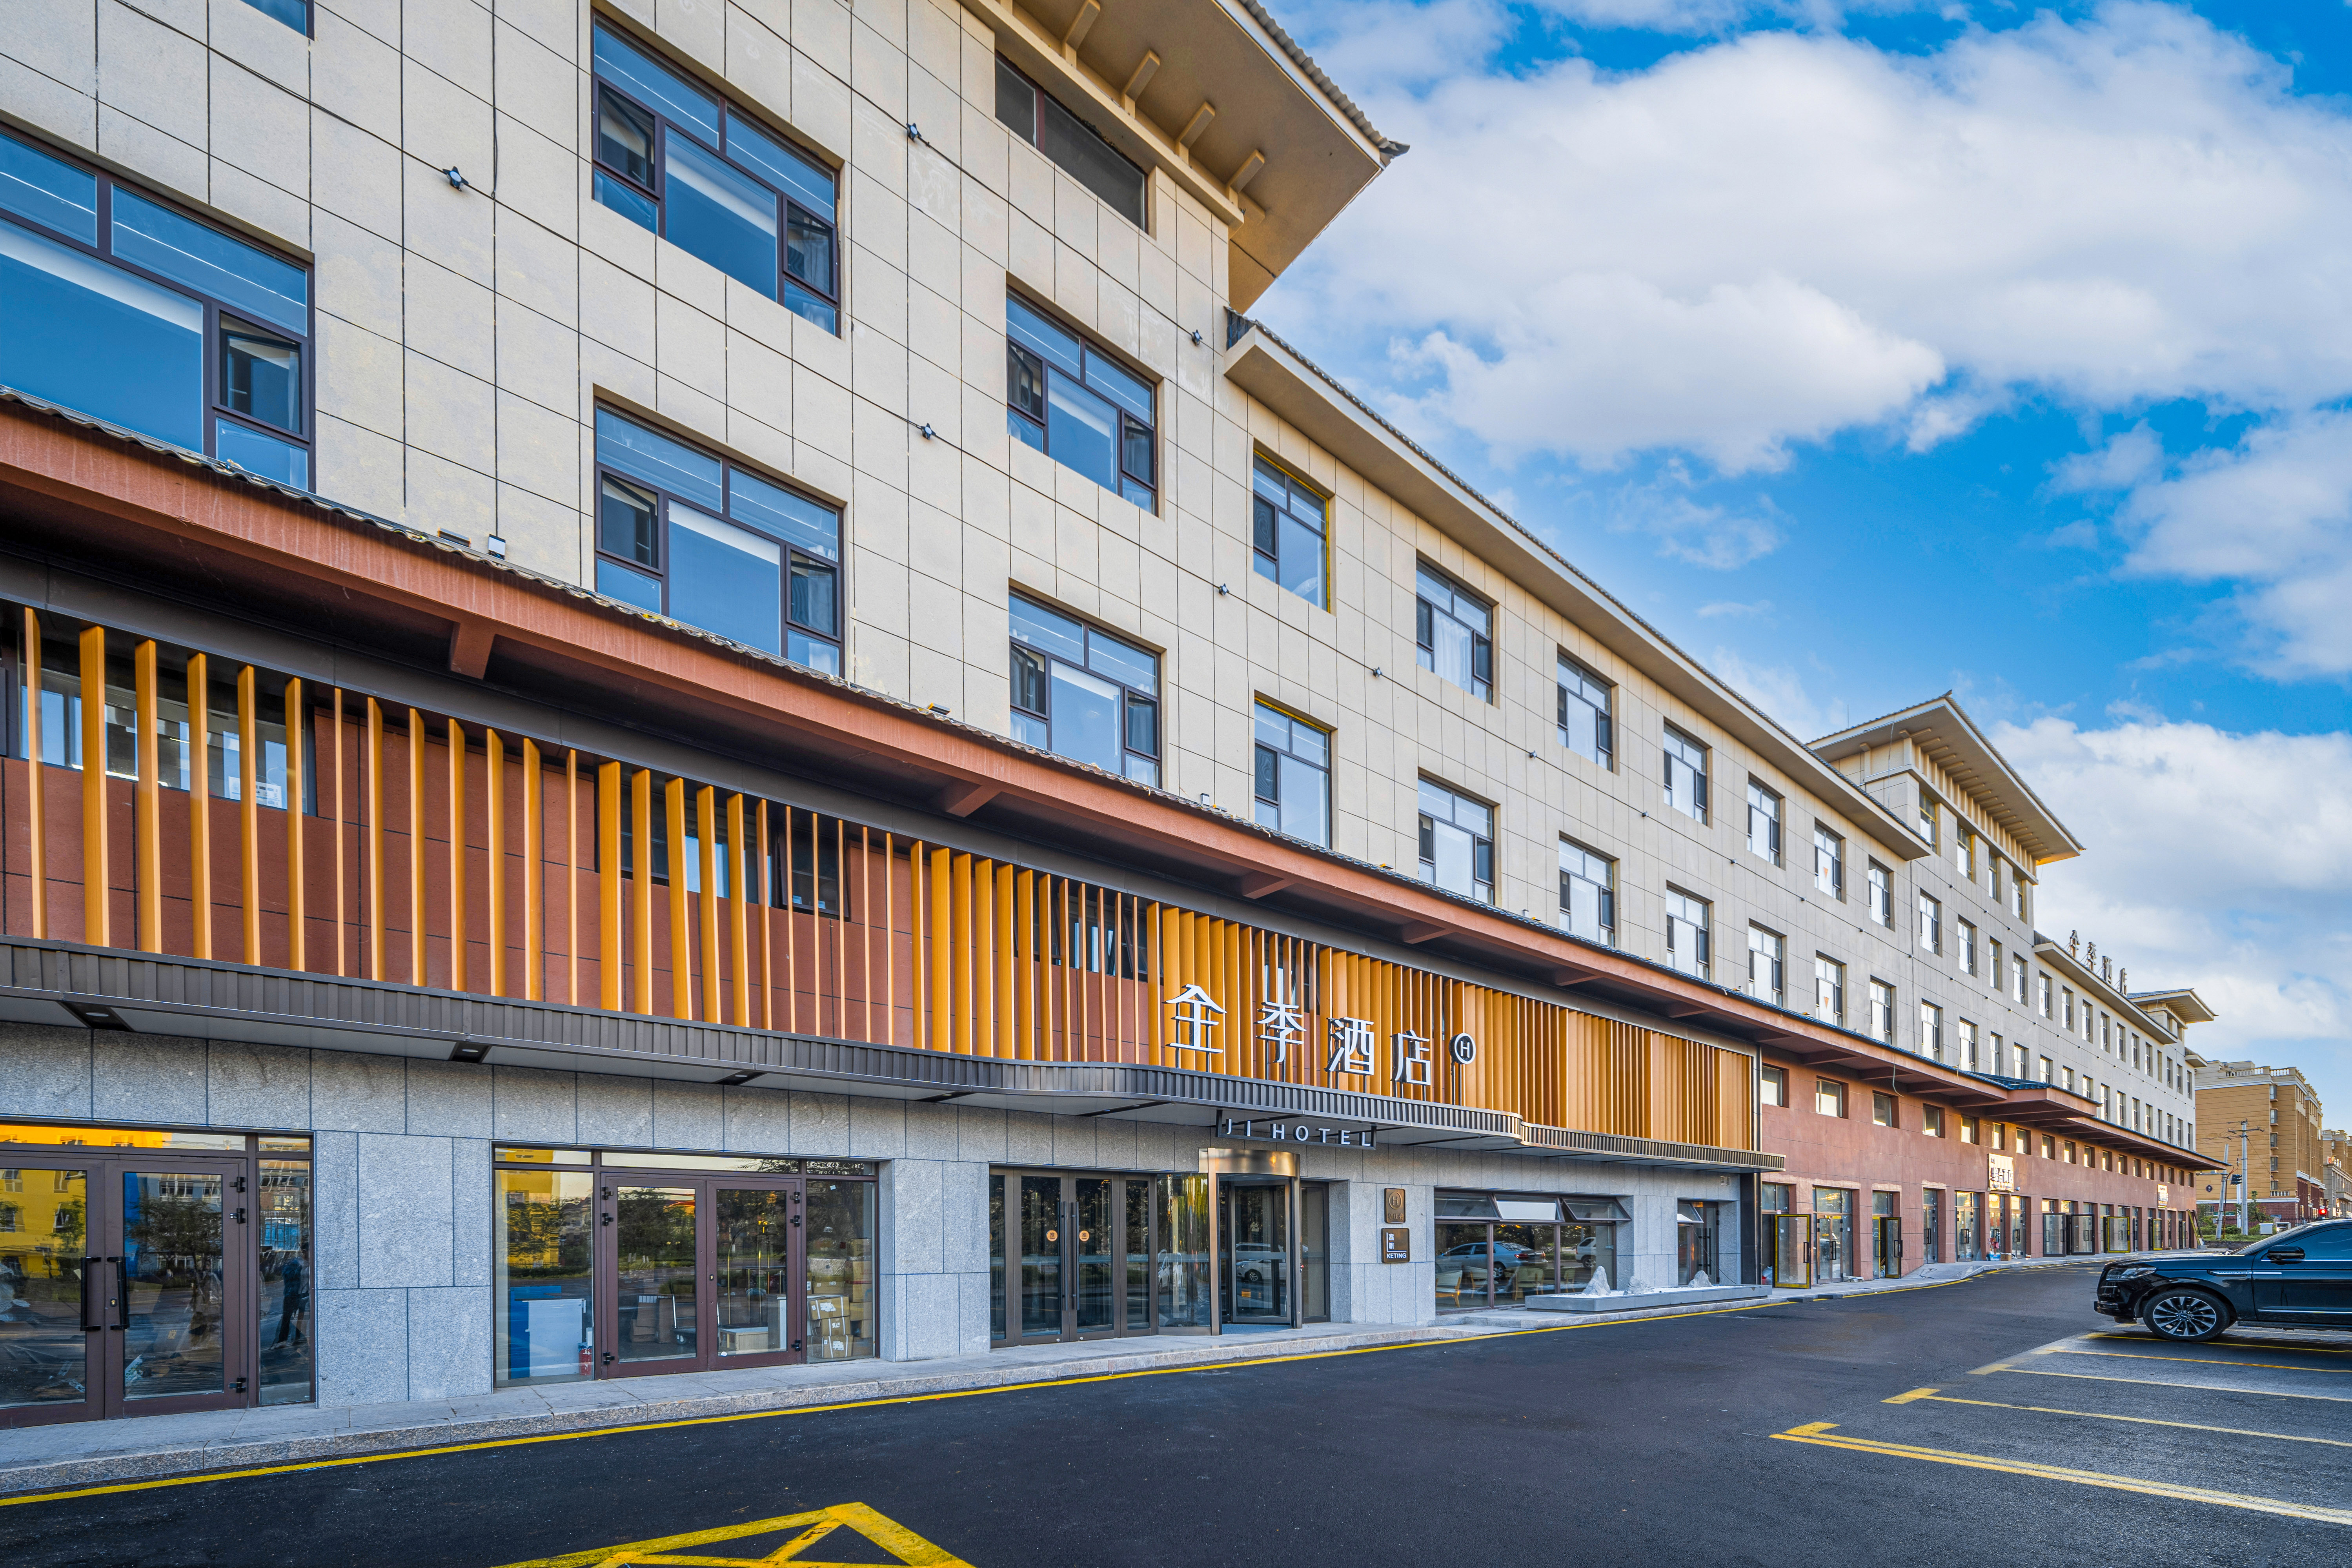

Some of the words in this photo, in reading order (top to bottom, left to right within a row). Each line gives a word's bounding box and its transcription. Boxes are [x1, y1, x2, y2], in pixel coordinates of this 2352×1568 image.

[1165, 983, 1431, 1086] 全季酒店
[1227, 1118, 1251, 1136] JI
[1272, 1123, 1371, 1146] HOTEL
